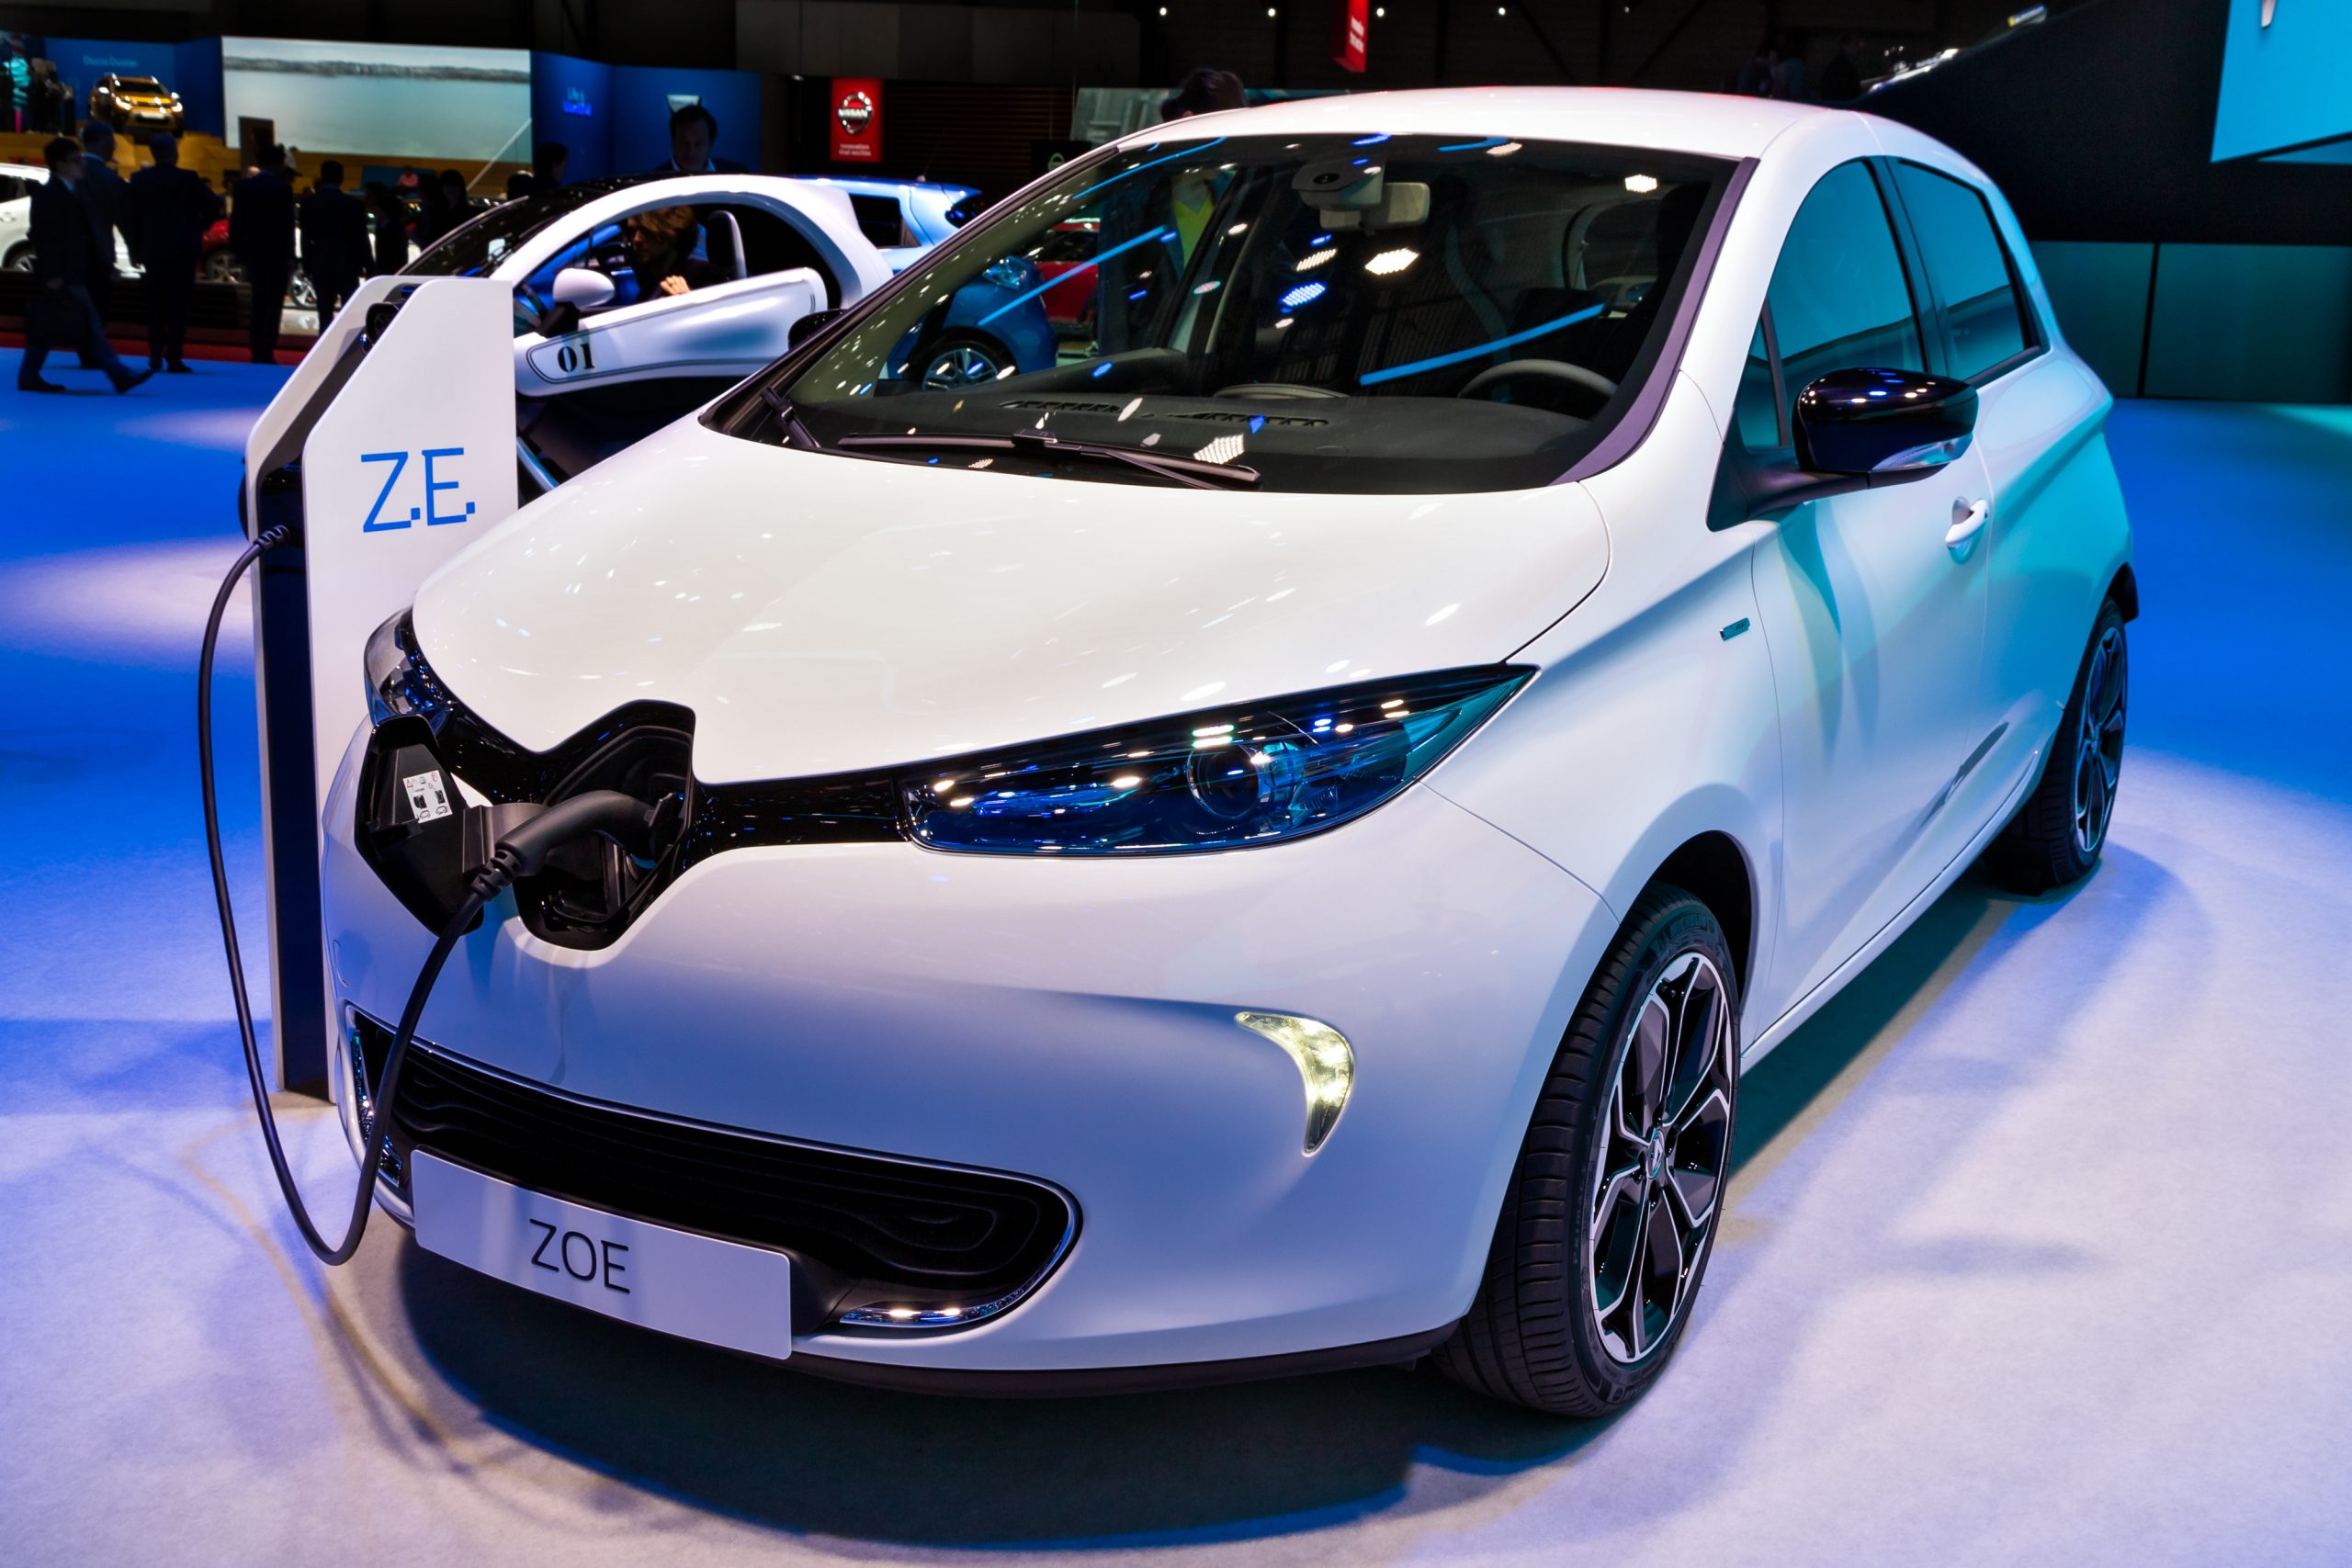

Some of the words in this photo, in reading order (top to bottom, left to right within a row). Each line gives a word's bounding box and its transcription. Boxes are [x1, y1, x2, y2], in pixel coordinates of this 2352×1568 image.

[838, 108, 868, 118] NISSAN
[557, 343, 595, 373] 01
[360, 446, 476, 533] Z.E.
[529, 1218, 630, 1294] ZOE
